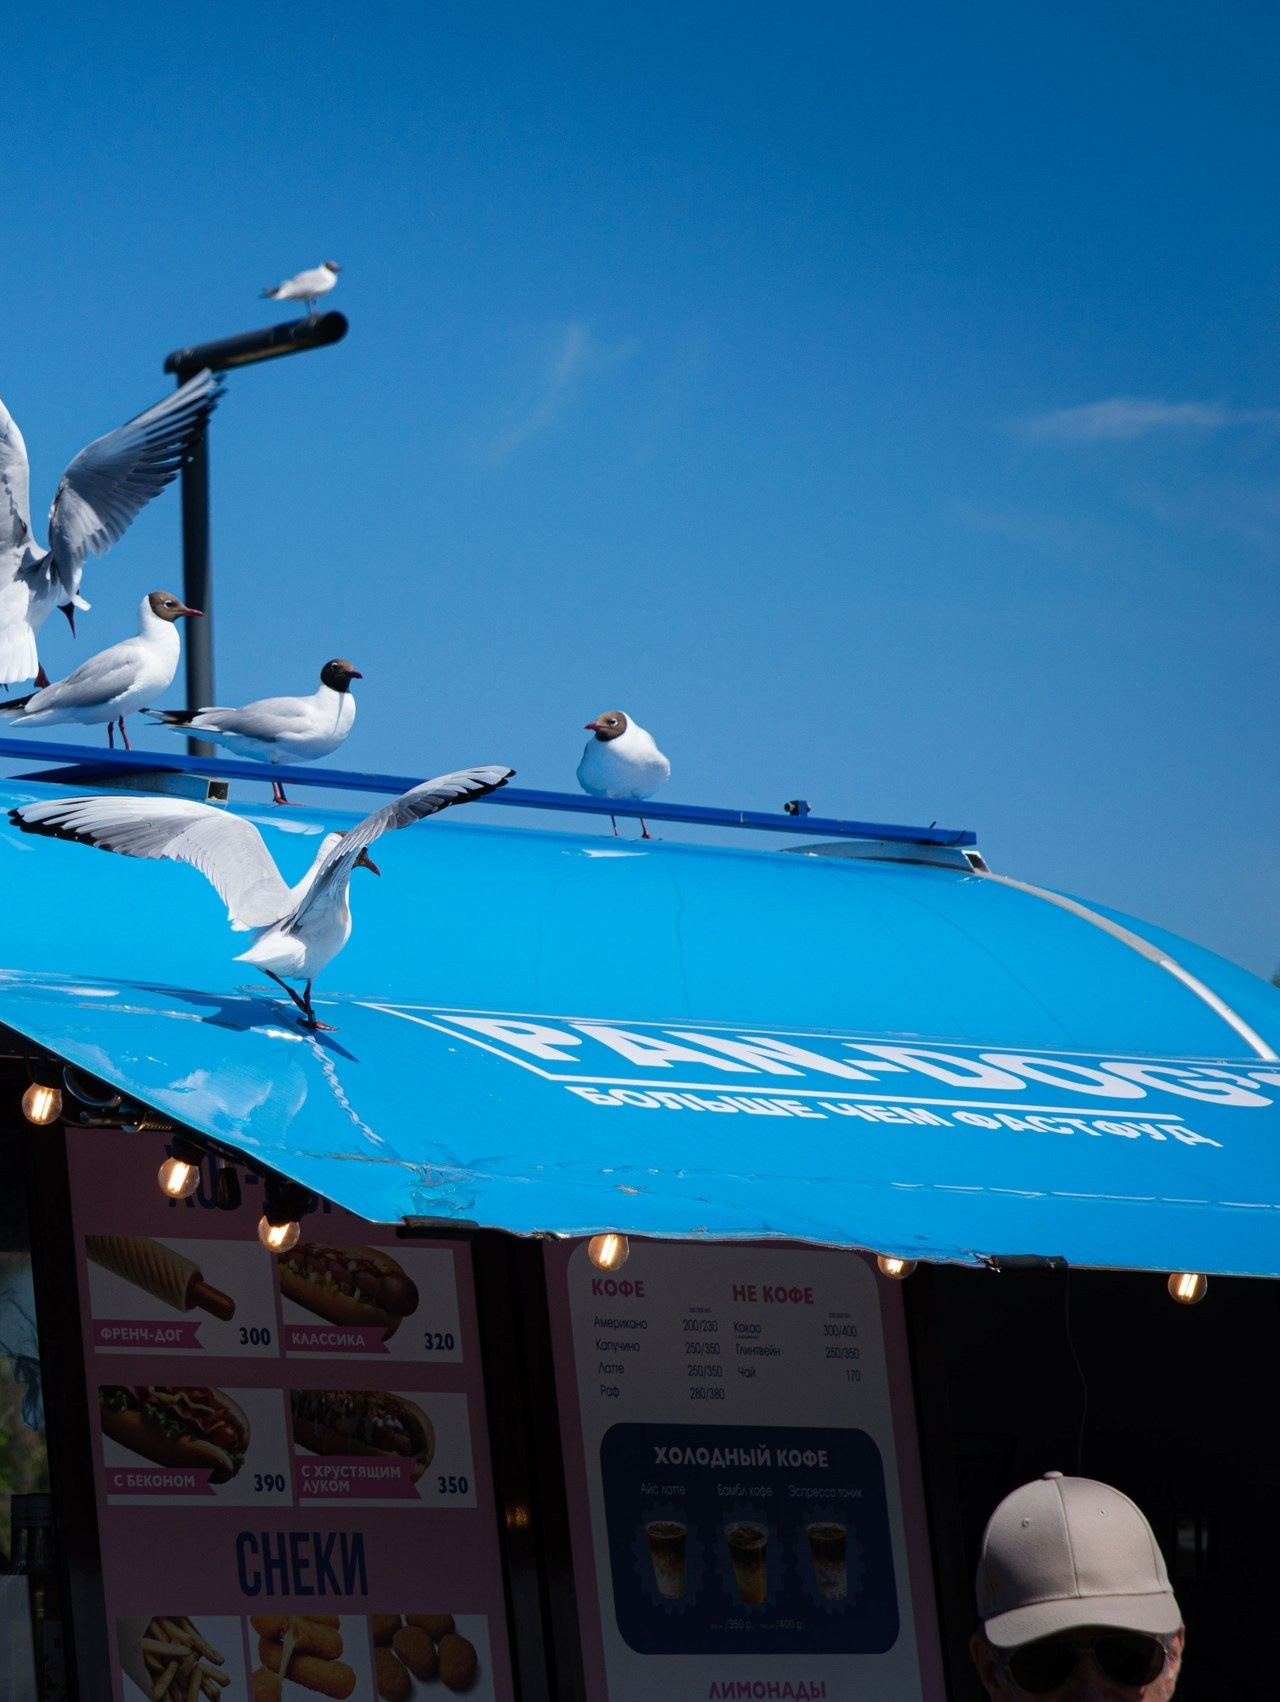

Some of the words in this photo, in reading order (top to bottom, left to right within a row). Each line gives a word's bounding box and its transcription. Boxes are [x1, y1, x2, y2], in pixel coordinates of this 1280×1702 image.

[564, 1086, 829, 1119] БОЛЬШЕ
[817, 1101, 955, 1127] ЧЕМ
[951, 1110, 1223, 1147] ФАСТФУД
[592, 1279, 645, 1297] КОФЕ
[732, 1285, 757, 1302] НЕ
[763, 1286, 814, 1304] КОФЕ
[593, 1316, 648, 1331] Американо
[683, 1319, 718, 1332] 200/230
[733, 1321, 762, 1333] Какао
[100, 1327, 183, 1344] ФРЕНЧ-ДОГ
[239, 1327, 271, 1346] 300
[823, 1325, 857, 1337] 300/400
[291, 1332, 365, 1347] КЛАССИКА
[424, 1333, 455, 1351] 320
[595, 1339, 640, 1353] Капучино
[685, 1342, 720, 1355] 250/350
[736, 1344, 780, 1357] Глинтвейн
[825, 1346, 860, 1360] 250/350
[599, 1362, 624, 1374] Латте
[687, 1364, 722, 1378] 250/350
[738, 1366, 757, 1378] Чай
[846, 1369, 861, 1382] 170
[600, 1385, 620, 1399] Раф
[689, 1387, 725, 1400] 280/380
[653, 1443, 771, 1468] ХОЛОДНЫЙ
[776, 1449, 829, 1468] КОФЕ
[301, 1465, 311, 1478] С
[313, 1465, 402, 1480] ХРУСТЯЩИМ
[114, 1475, 124, 1488] С
[127, 1475, 196, 1488] БЕКОНОМ
[254, 1474, 286, 1492] 390
[302, 1480, 351, 1493] ЛУКОМ
[438, 1476, 469, 1495] 350
[639, 1482, 659, 1496] Айс
[661, 1484, 687, 1496] латте
[717, 1483, 748, 1497] Бамбл
[749, 1485, 774, 1498] кофе
[787, 1485, 836, 1499] Эспрессо
[838, 1487, 863, 1498] тоник
[236, 1531, 368, 1597] СНЕКИ
[708, 1681, 827, 1701] ЛИМОНАДЫ
